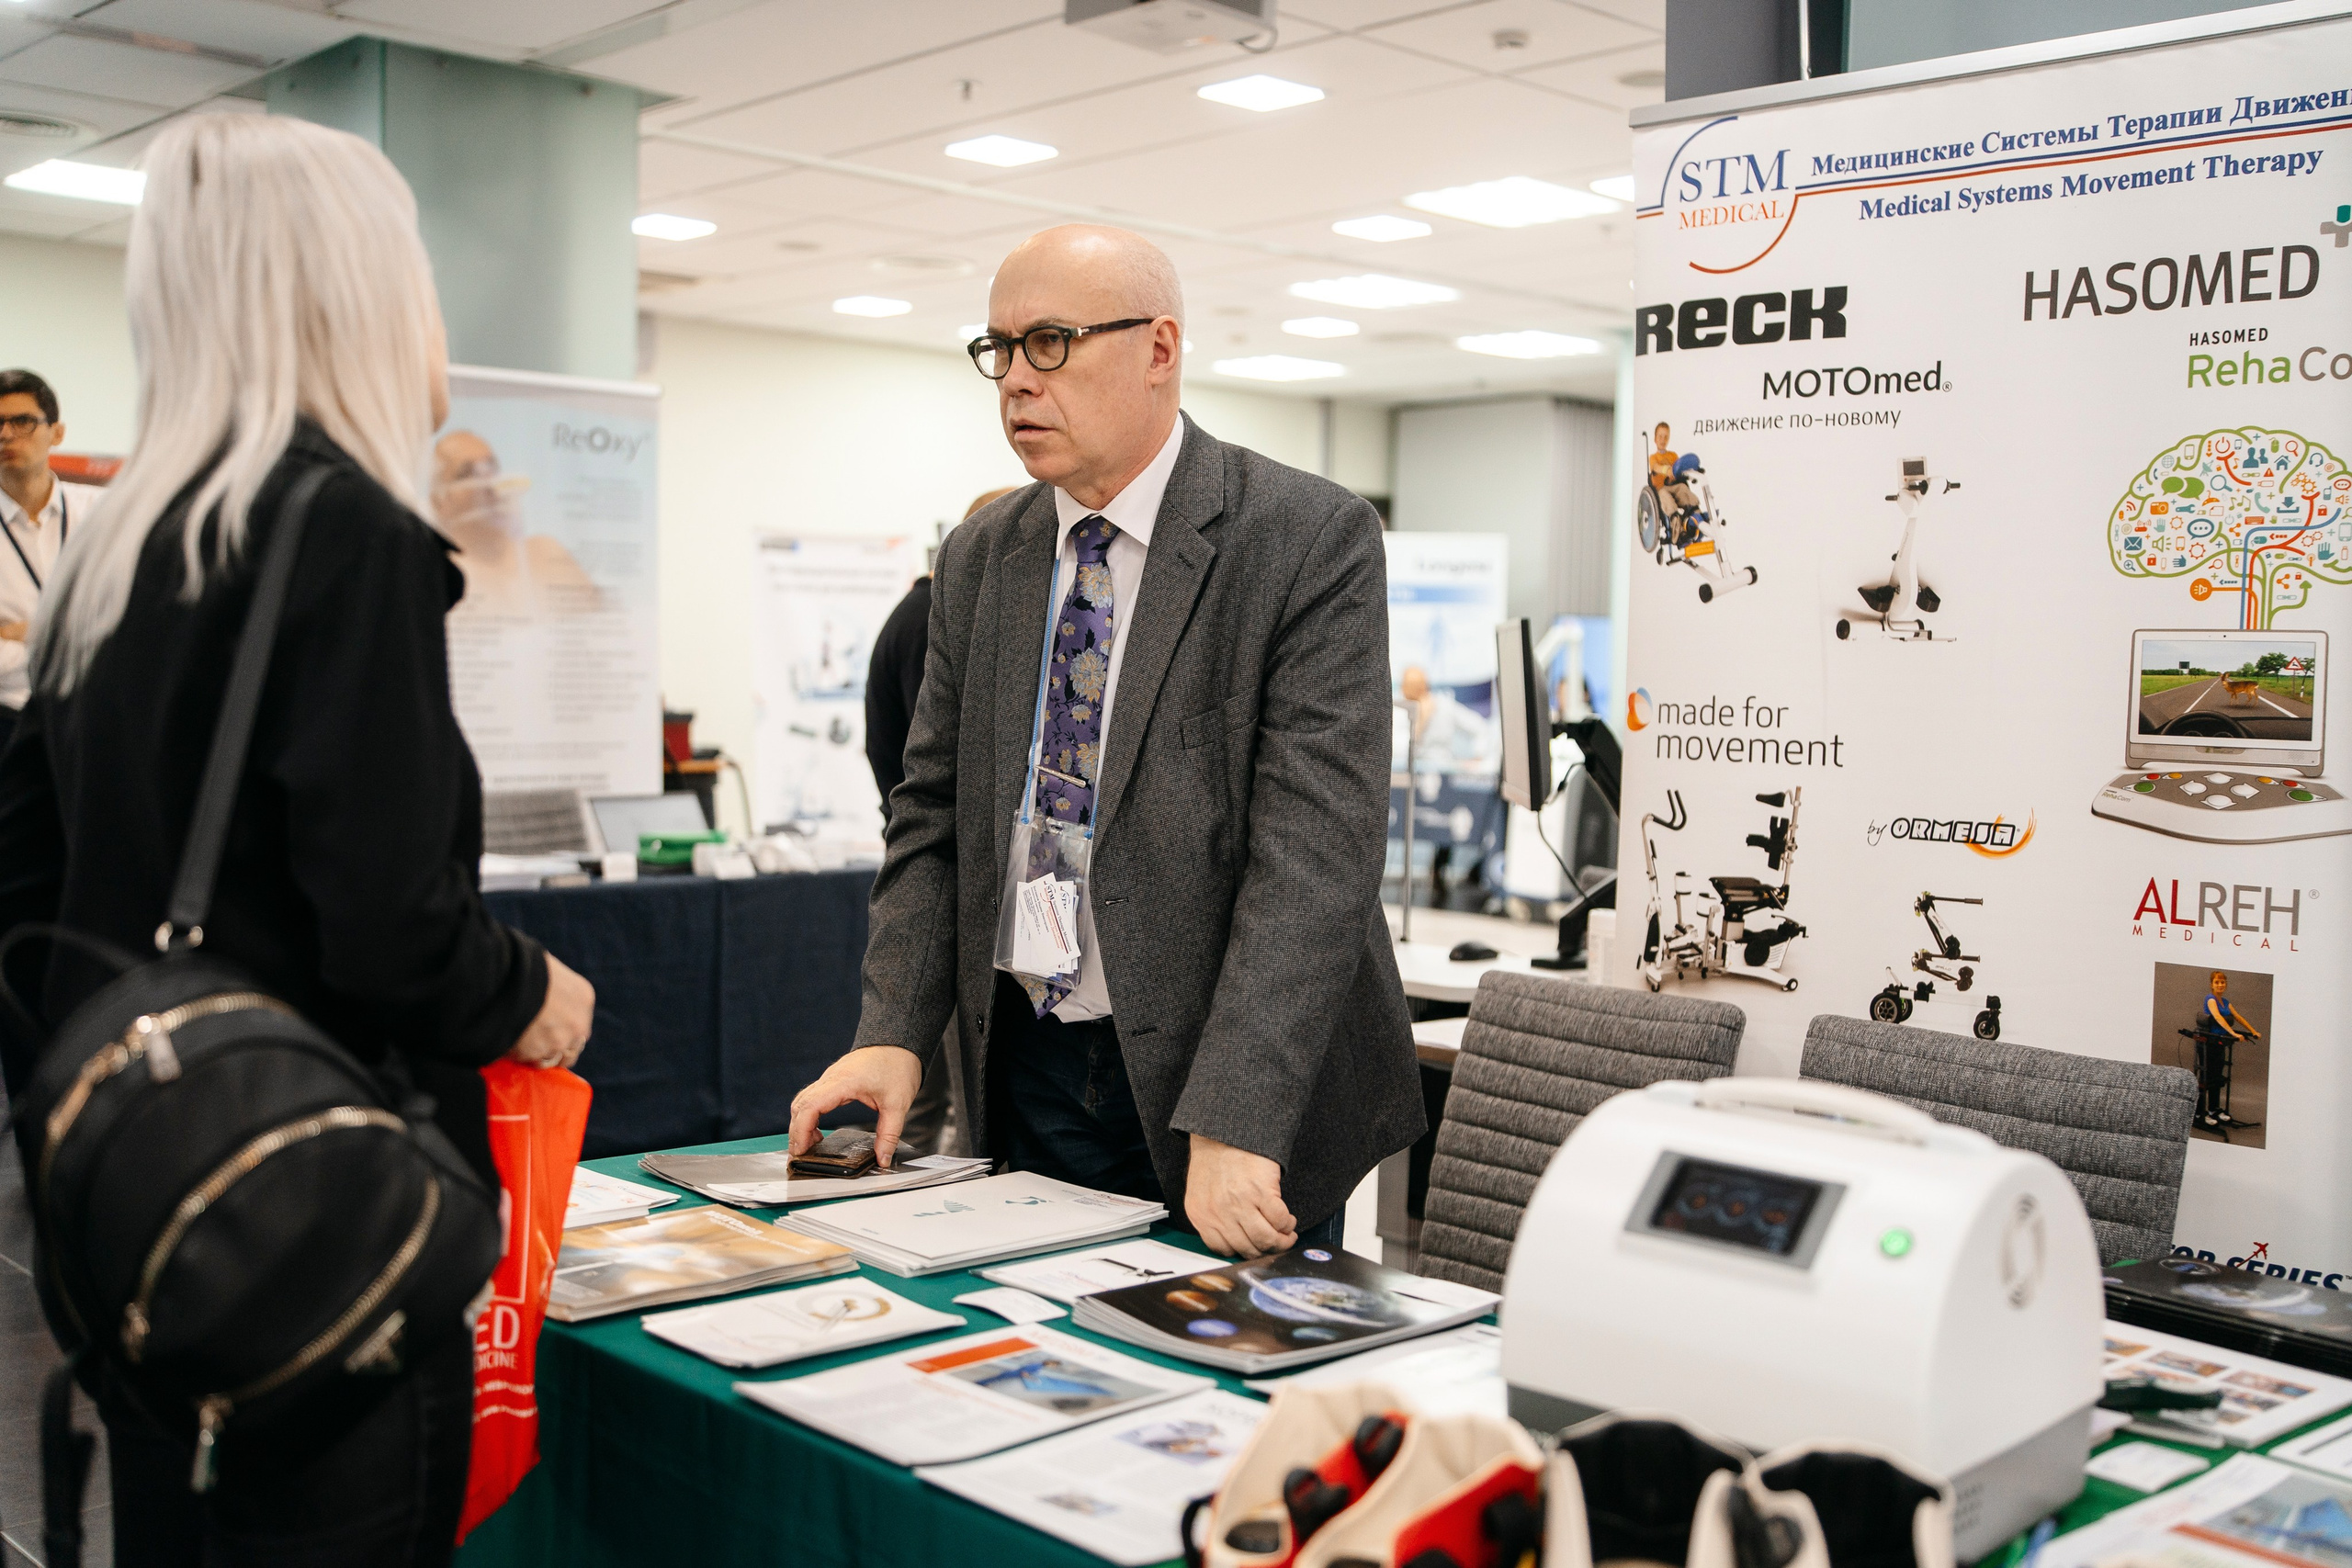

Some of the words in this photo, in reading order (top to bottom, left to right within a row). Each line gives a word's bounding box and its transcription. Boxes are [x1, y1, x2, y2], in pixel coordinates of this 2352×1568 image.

[1811, 142, 1974, 175] Медицинские
[1981, 125, 2098, 154] Системы
[2108, 106, 2222, 140] Терапии
[2230, 88, 2352, 126] Движен
[1679, 149, 1790, 202] STM
[1859, 190, 1951, 220] Medical
[1958, 182, 2052, 214] Systems
[2060, 161, 2195, 197] Movement
[2204, 150, 2324, 179] Therapy
[1679, 200, 1784, 230] MEDICAL
[2024, 244, 2320, 321] HASOMED
[2189, 327, 2268, 346] HASOMED
[1693, 414, 1784, 435] движение
[1790, 410, 1901, 429] по-новому
[1657, 694, 1735, 728] made
[1742, 695, 1790, 728] for
[1657, 734, 1844, 768] movement
[1867, 818, 1888, 847] by
[2132, 876, 2301, 936] ALREH
[2132, 924, 2299, 952] MEDICAL
